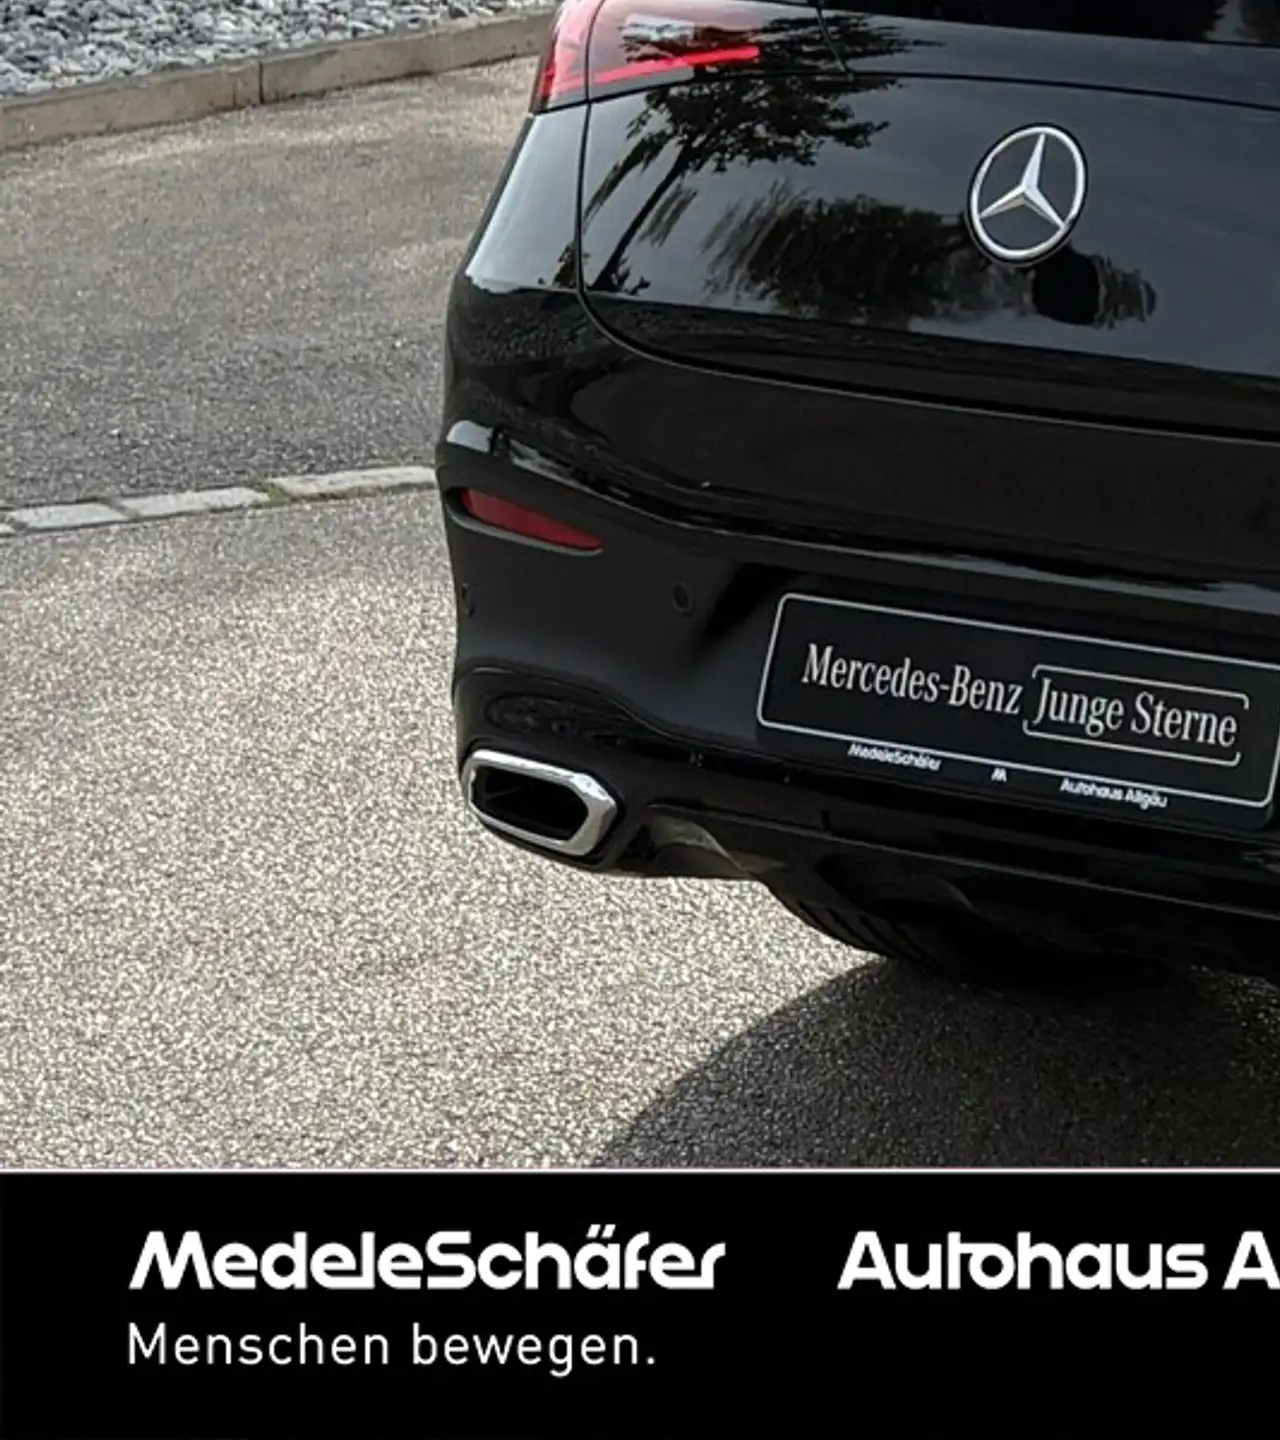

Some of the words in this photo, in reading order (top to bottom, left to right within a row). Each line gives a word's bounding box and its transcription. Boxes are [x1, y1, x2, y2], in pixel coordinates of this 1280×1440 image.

[801, 643, 1022, 715] Mercedes-Benz
[1033, 677, 1124, 737] Junge
[1130, 692, 1238, 747] Sterne
[1060, 777, 1124, 801] Autohaus
[1124, 787, 1168, 811] Allgäu
